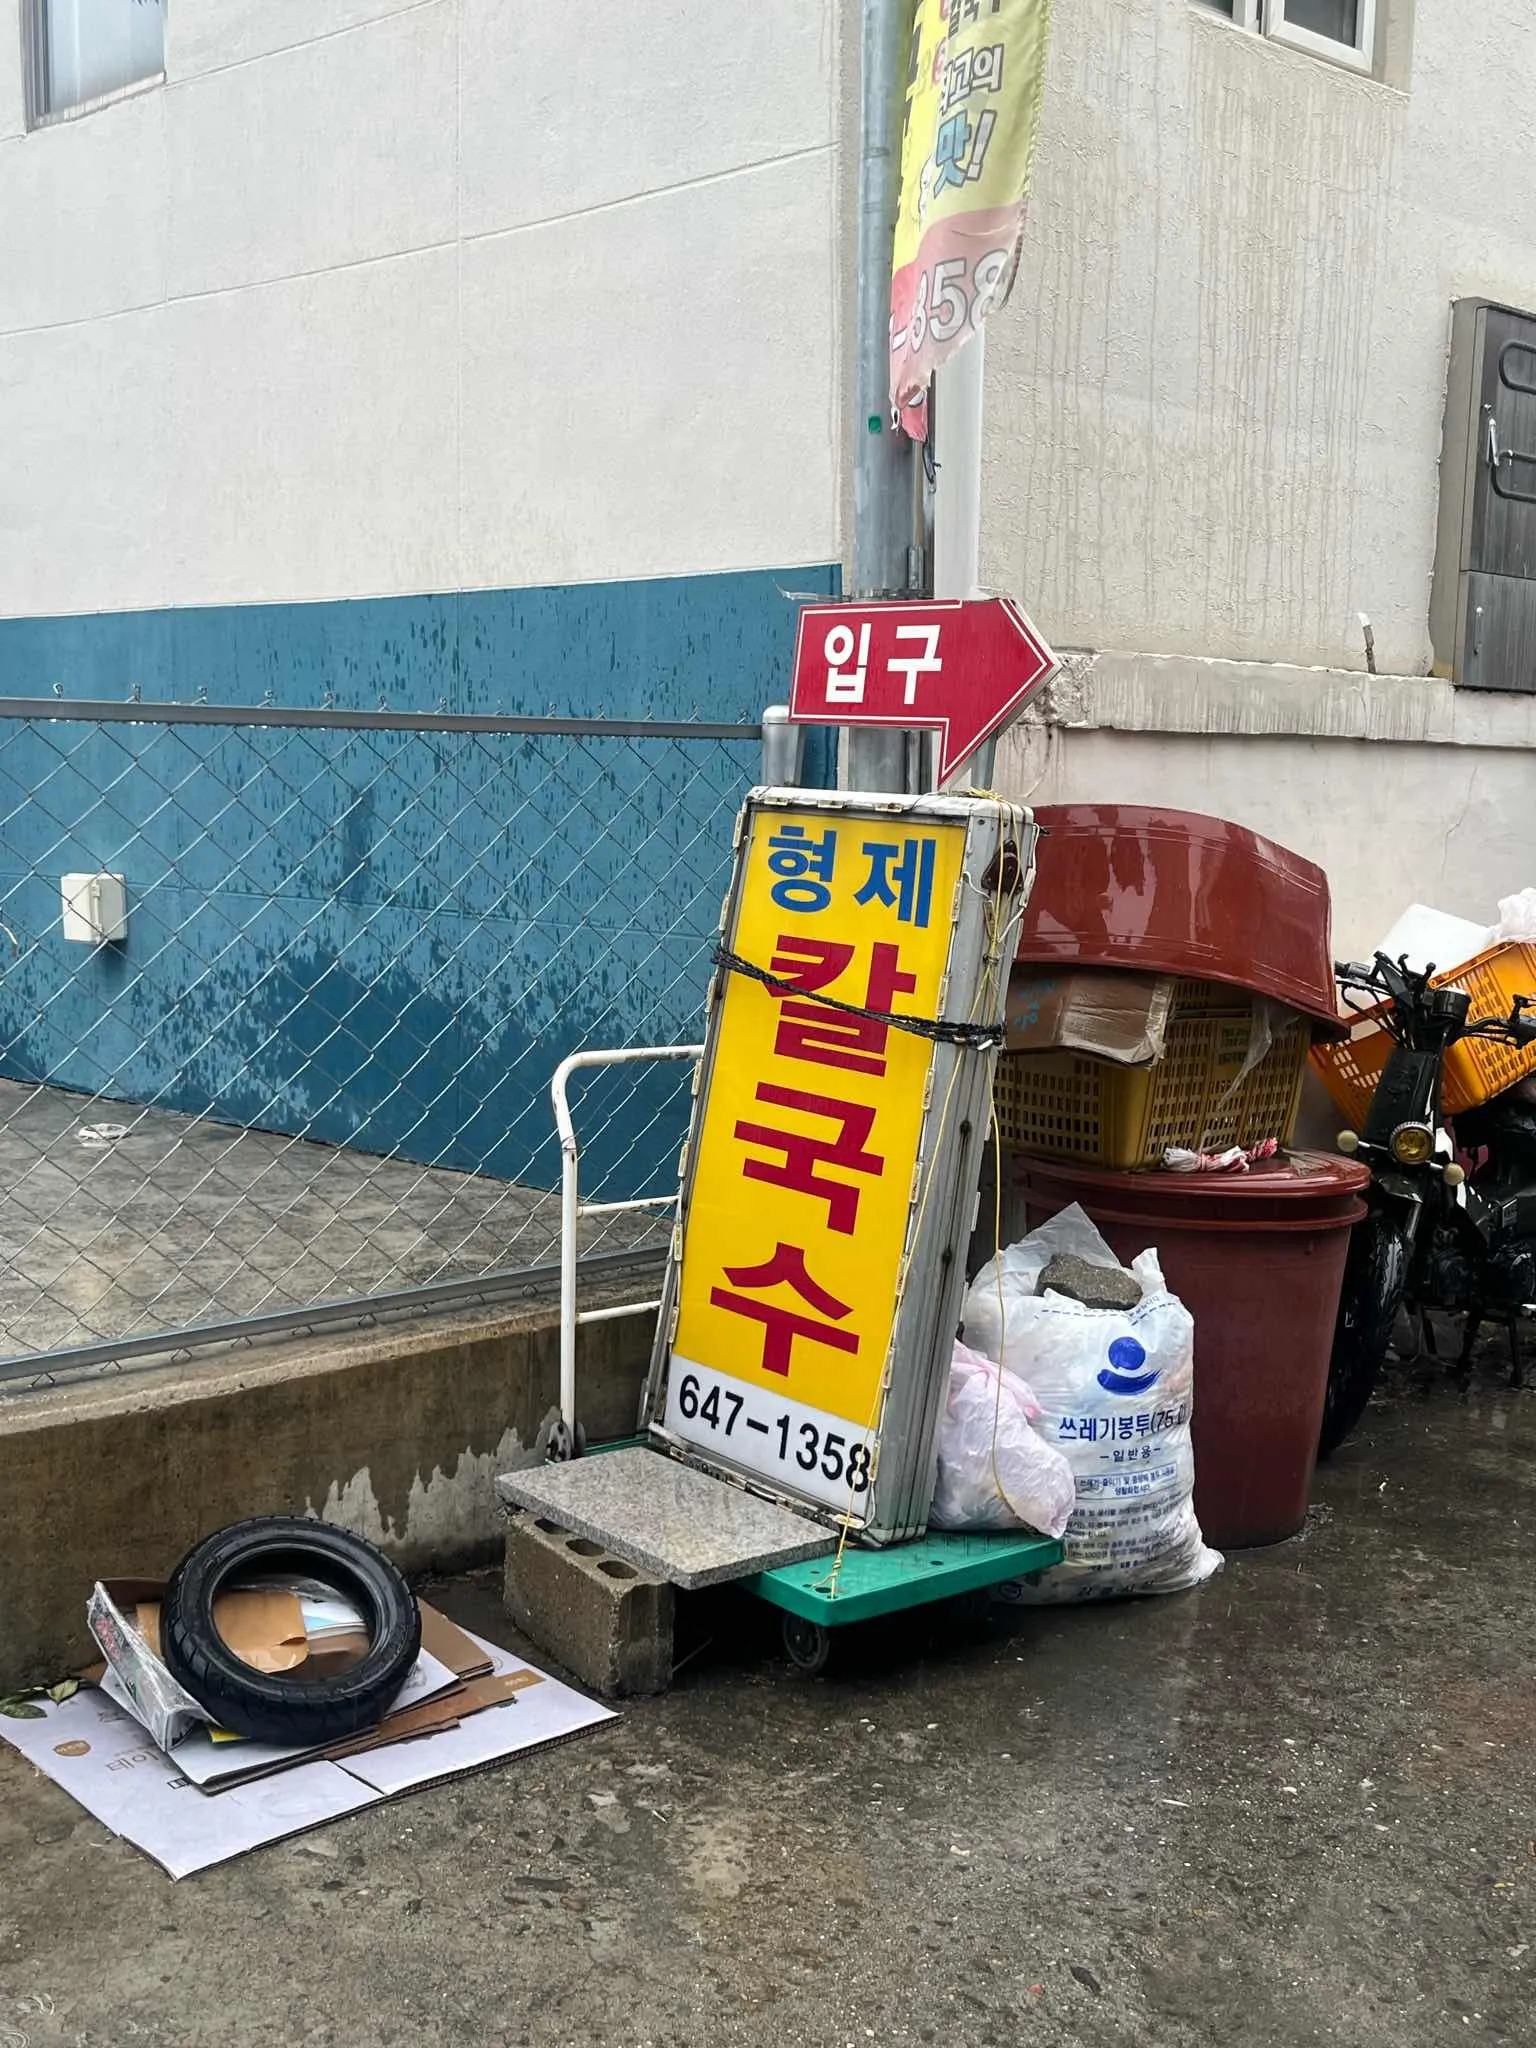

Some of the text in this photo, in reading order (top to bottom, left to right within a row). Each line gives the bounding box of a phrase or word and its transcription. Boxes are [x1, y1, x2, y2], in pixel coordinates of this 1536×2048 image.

[933, 109, 998, 199] 맛!
[824, 624, 944, 705] 입구
[768, 824, 938, 928] 형제
[710, 933, 917, 1378] 칼국수
[679, 1374, 872, 1493] 647-1358
